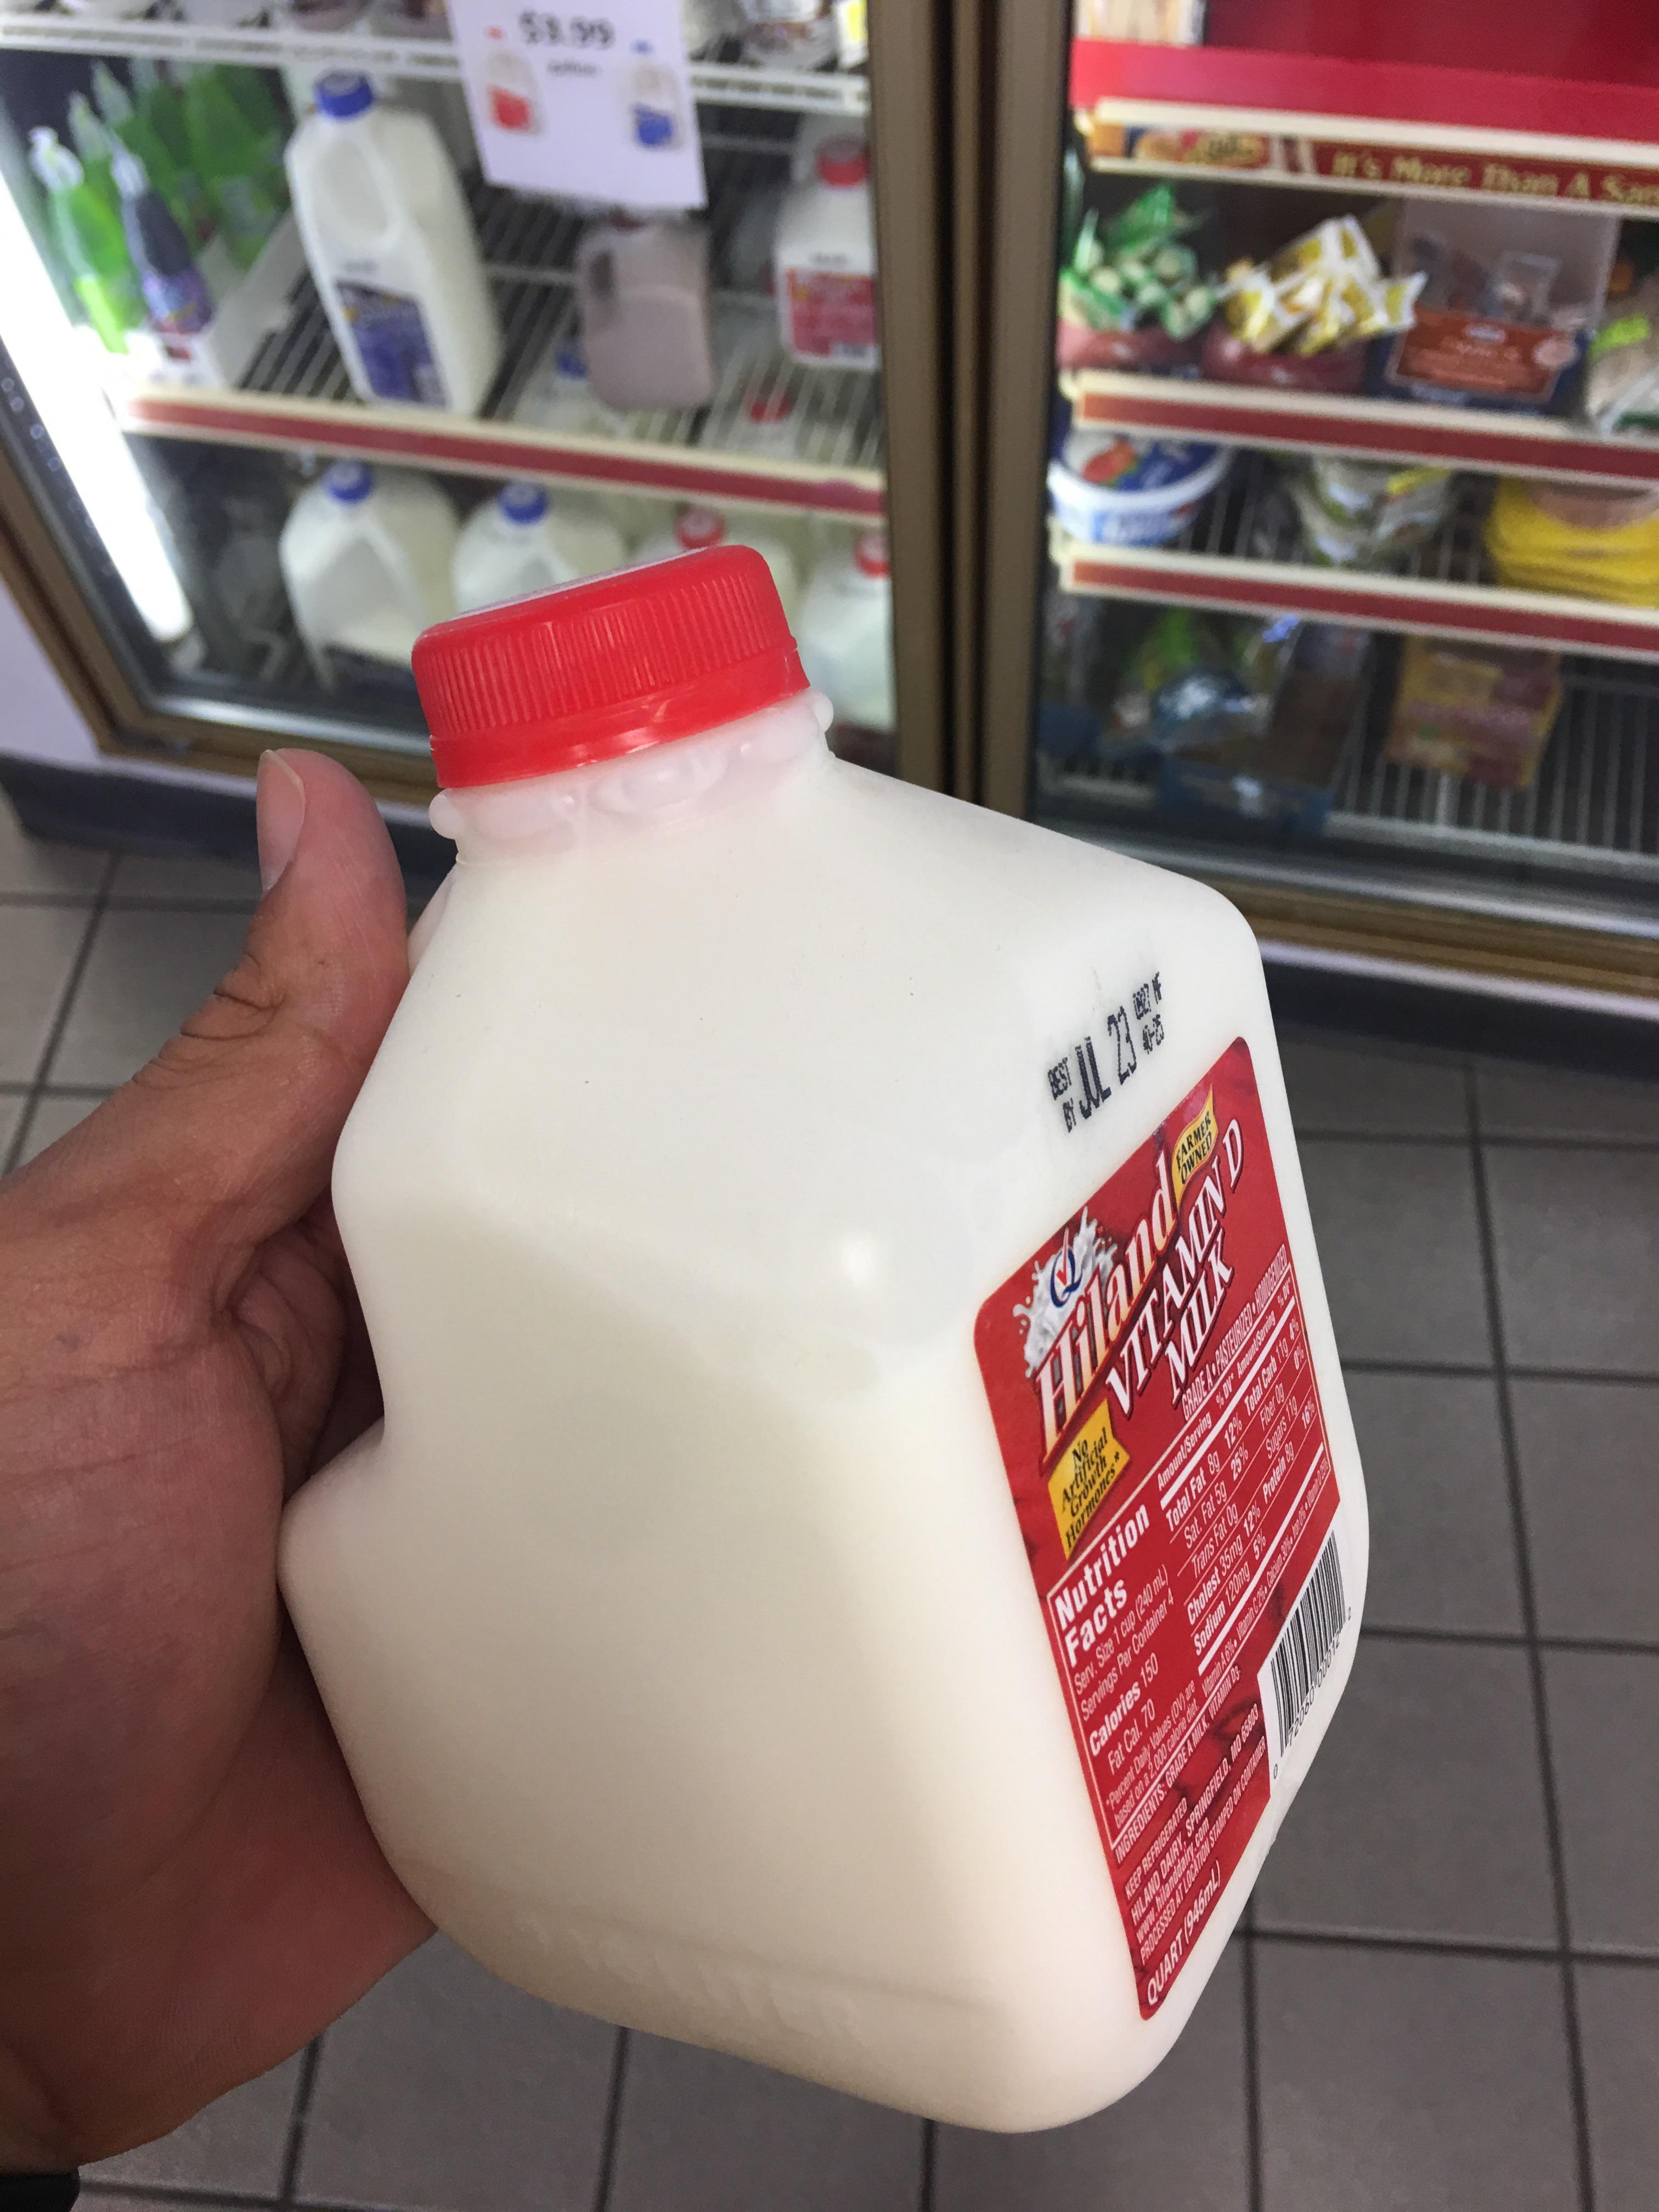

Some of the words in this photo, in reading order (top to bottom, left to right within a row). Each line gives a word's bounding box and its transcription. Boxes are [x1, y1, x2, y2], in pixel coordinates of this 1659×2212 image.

[1563, 172, 1590, 198] A
[1047, 1057, 1071, 1101] BEST
[1062, 1097, 1076, 1133] BY
[1075, 1036, 1111, 1119] JUL
[1107, 1006, 1137, 1085] 23
[1176, 1109, 1211, 1171] FARMER
[1180, 1131, 1212, 1186] OWNED
[1035, 1149, 1176, 1464] Hiland
[1104, 1155, 1223, 1413] VITAMIN
[1223, 1119, 1242, 1189] D
[1164, 1228, 1232, 1406] MILK
[1182, 1370, 1207, 1421] GRADE
[1206, 1363, 1213, 1391] A
[1215, 1303, 1254, 1375] PASTEURIZED
[1255, 1244, 1287, 1313] HOMOGENIZED
[1071, 1440, 1088, 1469] No
[1158, 1412, 1211, 1491] Amount/Serving
[1216, 1391, 1224, 1409] %
[1237, 1310, 1276, 1378] Amount/Serving
[1165, 1487, 1191, 1532] Total
[1189, 1467, 1206, 1500] Fat
[1207, 1451, 1221, 1475] 8g
[1224, 1412, 1242, 1449] 12%
[1244, 1376, 1263, 1416] Total
[1261, 1355, 1277, 1389] Carb
[1276, 1338, 1289, 1363] 11g
[1289, 1315, 1299, 1340] 4%
[1184, 1516, 1202, 1549] Sat.
[1201, 1493, 1216, 1525] Fat
[1214, 1480, 1227, 1505] 5g
[1231, 1442, 1248, 1481] 25%
[1260, 1396, 1276, 1431] Fiber
[1275, 1383, 1286, 1404] 0g
[1294, 1342, 1304, 1370] 0%
[1062, 1425, 1108, 1513] Artificial
[1070, 1456, 1107, 1517] Growth
[1187, 1566, 1221, 1625] Cholest
[1220, 1534, 1244, 1576] 35mg
[1243, 1500, 1260, 1537] 12%
[1262, 1456, 1286, 1504] Protein
[1285, 1441, 1295, 1463] 8g
[1301, 1397, 1314, 1429] 16%
[1192, 1537, 1215, 1578] Trans
[1213, 1516, 1227, 1547] Fat
[1226, 1502, 1240, 1526] 0g
[1266, 1416, 1287, 1459] Sugars
[1285, 1396, 1299, 1422] 11g
[1055, 1505, 1149, 1630] Nutrition
[1065, 1580, 1127, 1667] Facts
[1074, 1661, 1097, 1695] Serv.
[1096, 1638, 1114, 1668] Size
[1113, 1626, 1120, 1644] 1
[1120, 1610, 1136, 1637] cup
[1135, 1583, 1153, 1622] (240
[1152, 1564, 1168, 1595] mL)
[1194, 1601, 1226, 1655] Sodium
[1226, 1561, 1250, 1606] 120mg
[1253, 1529, 1266, 1560] 5%
[1201, 1662, 1222, 1697] Vitamin
[1221, 1651, 1227, 1670] A
[1236, 1607, 1255, 1640] Vitamin
[1252, 1596, 1259, 1614] C
[1266, 1554, 1283, 1588] Calcium
[1081, 1667, 1118, 1722] Servings
[1117, 1646, 1132, 1675] Per
[1132, 1599, 1167, 1655] Container
[1168, 1587, 1173, 1605] 4
[1090, 1682, 1140, 1756] Calories
[1140, 1652, 1158, 1688] 150
[1108, 1742, 1125, 1775] Fat
[1124, 1718, 1142, 1753] Cal.
[1141, 1699, 1155, 1729] 70
[1114, 1790, 1135, 1829] based
[1135, 1780, 1144, 1799] on
[1143, 1772, 1150, 1787] a
[1148, 1743, 1167, 1779] 2,000
[1167, 1717, 1187, 1752] calorie
[1186, 1698, 1199, 1723] diet.
[1115, 1784, 1166, 1863] INGREDIENTS:
[1165, 1747, 1187, 1788] GRADE
[1187, 1739, 1193, 1757] A
[1208, 1675, 1232, 1719] VITAMIN
[1133, 1744, 1151, 1774] Daily
[1149, 1715, 1172, 1750] Values
[1171, 1692, 1186, 1724] (DV)
[1185, 1680, 1195, 1701] are
[1272, 1762, 1278, 1780] 0
[1288, 1685, 1313, 1746] 72060
[1125, 1866, 1142, 1900] KEEP
[1142, 1797, 1187, 1874] REFRIGERATED
[1131, 1871, 1160, 1926] HILAND
[1160, 1831, 1186, 1879] DAIRY,
[1186, 1758, 1231, 1837] SPRINGFIELD,
[1231, 1734, 1242, 1762] MO
[1241, 1703, 1259, 1742] 65803
[1141, 1898, 1175, 1965] PROCESSED
[1175, 1882, 1183, 1908] AT
[1183, 1838, 1210, 1893] LOCATION
[1209, 1796, 1233, 1848] STAMPED
[1233, 1781, 1241, 1805] ON
[1240, 1736, 1266, 1791] CONTAINER
[1137, 1818, 1209, 1943] www.hilanddairy.com
[1148, 1929, 1182, 2005] QUART
[1186, 1860, 1220, 1943] (946mL)
